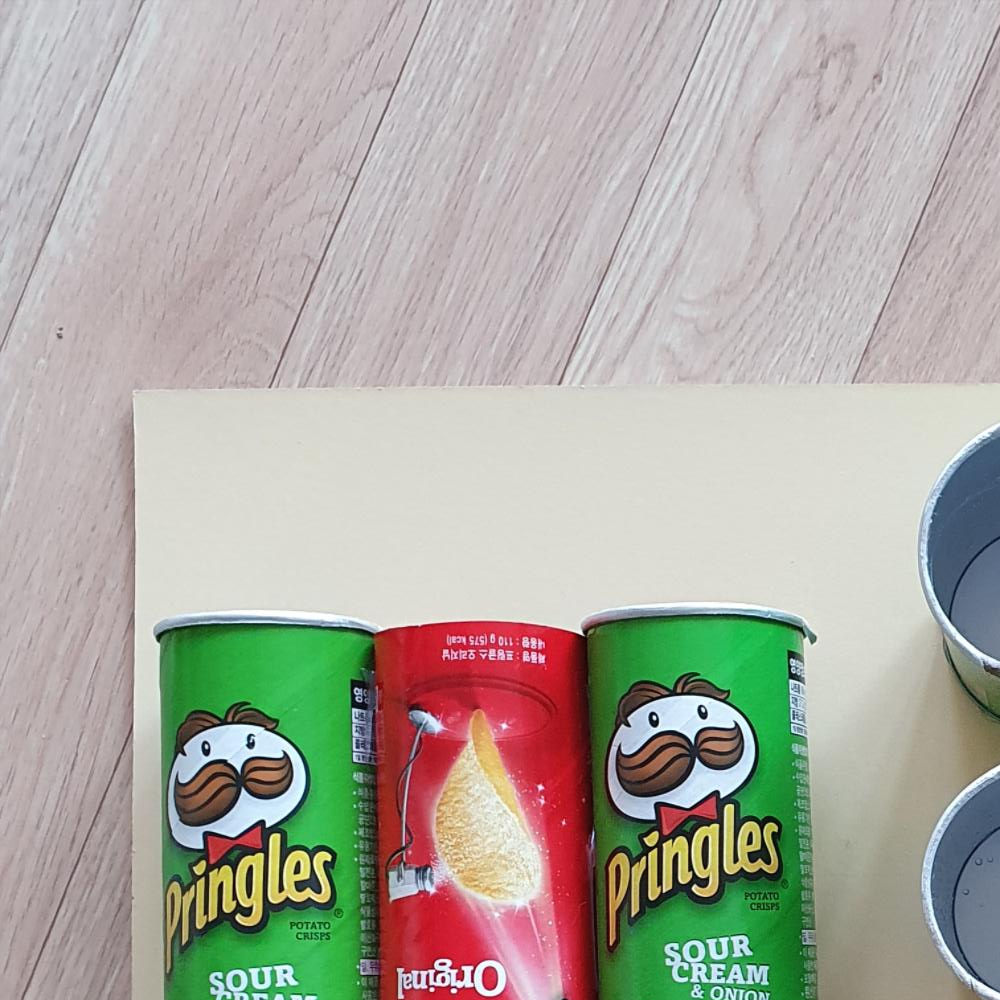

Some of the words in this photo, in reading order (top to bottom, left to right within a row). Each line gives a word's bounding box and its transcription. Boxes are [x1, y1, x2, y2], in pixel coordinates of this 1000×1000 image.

[446, 634, 466, 646] kcal)
[469, 634, 488, 646] (575
[490, 633, 496, 644] g
[498, 636, 514, 646] 110
[479, 649, 514, 661] 프링글스
[607, 802, 780, 949] Pringles
[744, 891, 780, 901] POTATO
[164, 831, 334, 976] Pringles
[750, 902, 780, 911] CRISPS
[289, 920, 331, 930] POTATO
[295, 931, 331, 941] CRISPS
[663, 934, 753, 968] SOUR
[396, 958, 507, 1000] Original
[671, 960, 770, 986] CREAM
[208, 964, 299, 997] SOUR
[690, 984, 705, 999] &
